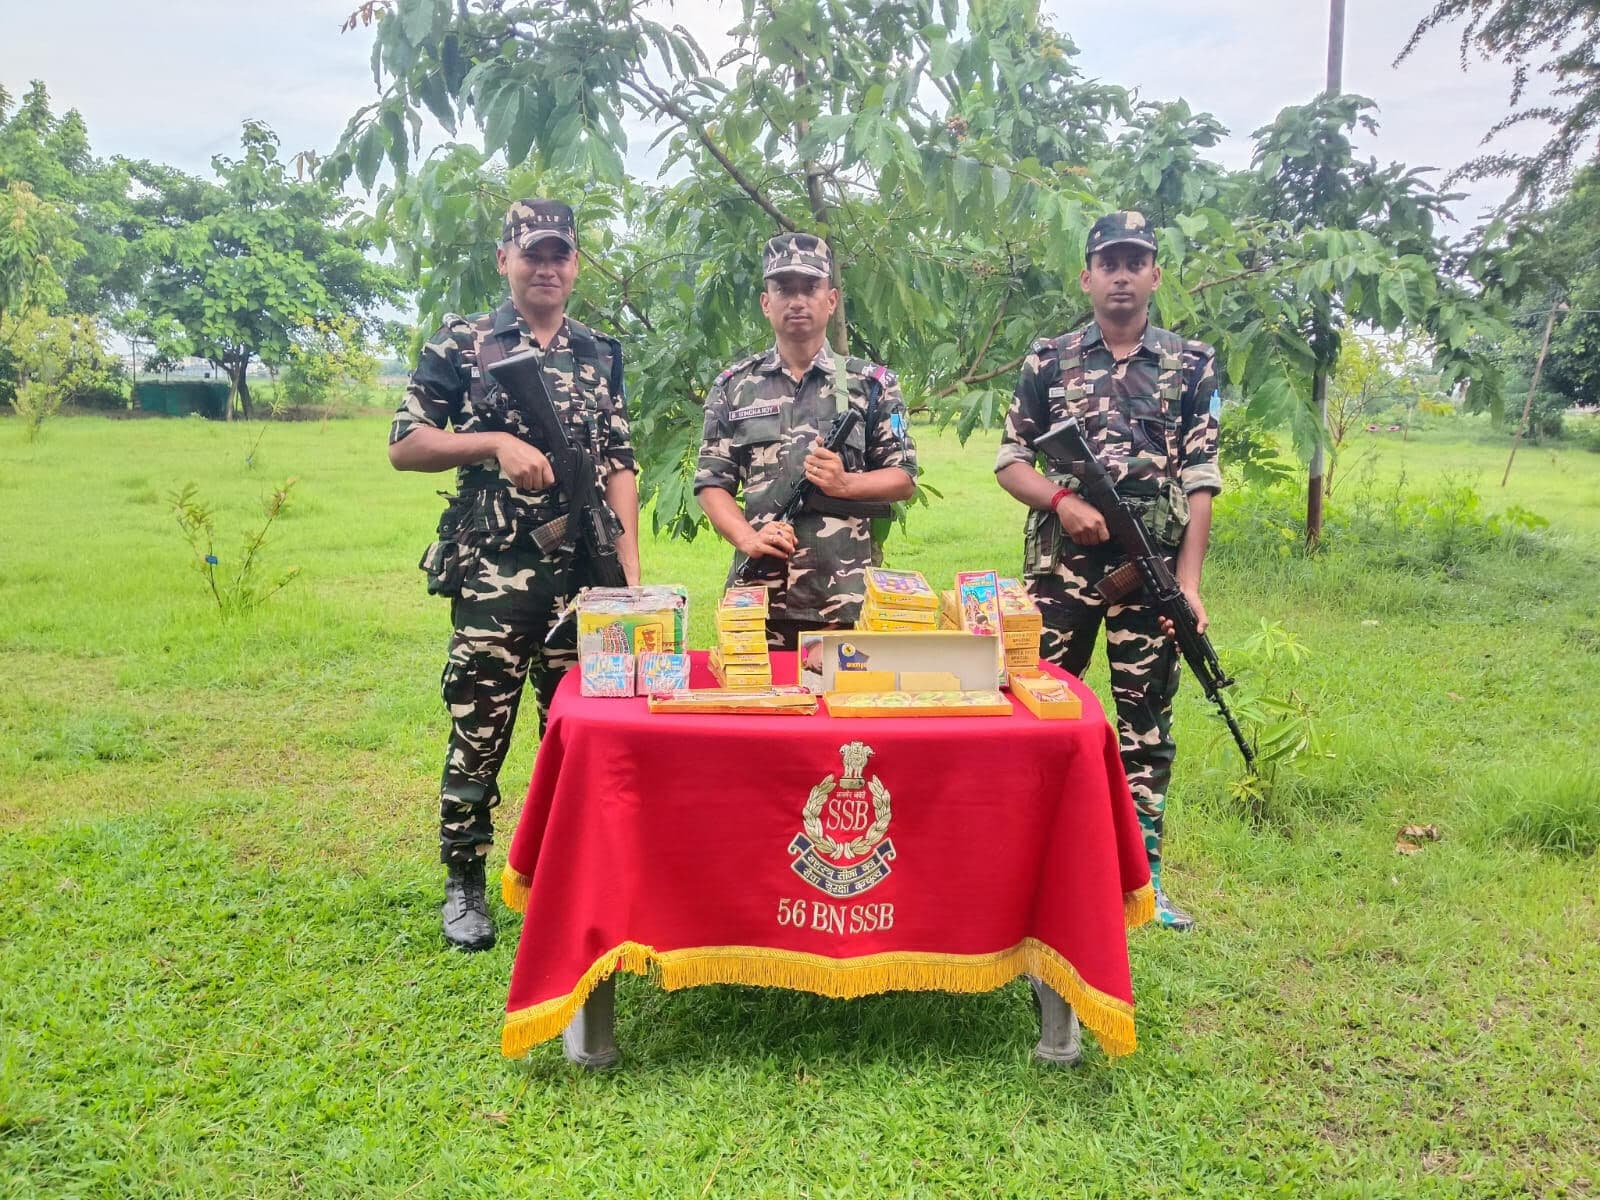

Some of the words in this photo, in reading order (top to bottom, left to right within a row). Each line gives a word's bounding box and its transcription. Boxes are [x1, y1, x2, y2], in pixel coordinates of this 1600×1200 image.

[827, 799, 869, 831] SSB
[777, 898, 806, 928] 56
[811, 901, 847, 936] BN
[850, 903, 895, 934] SSB
